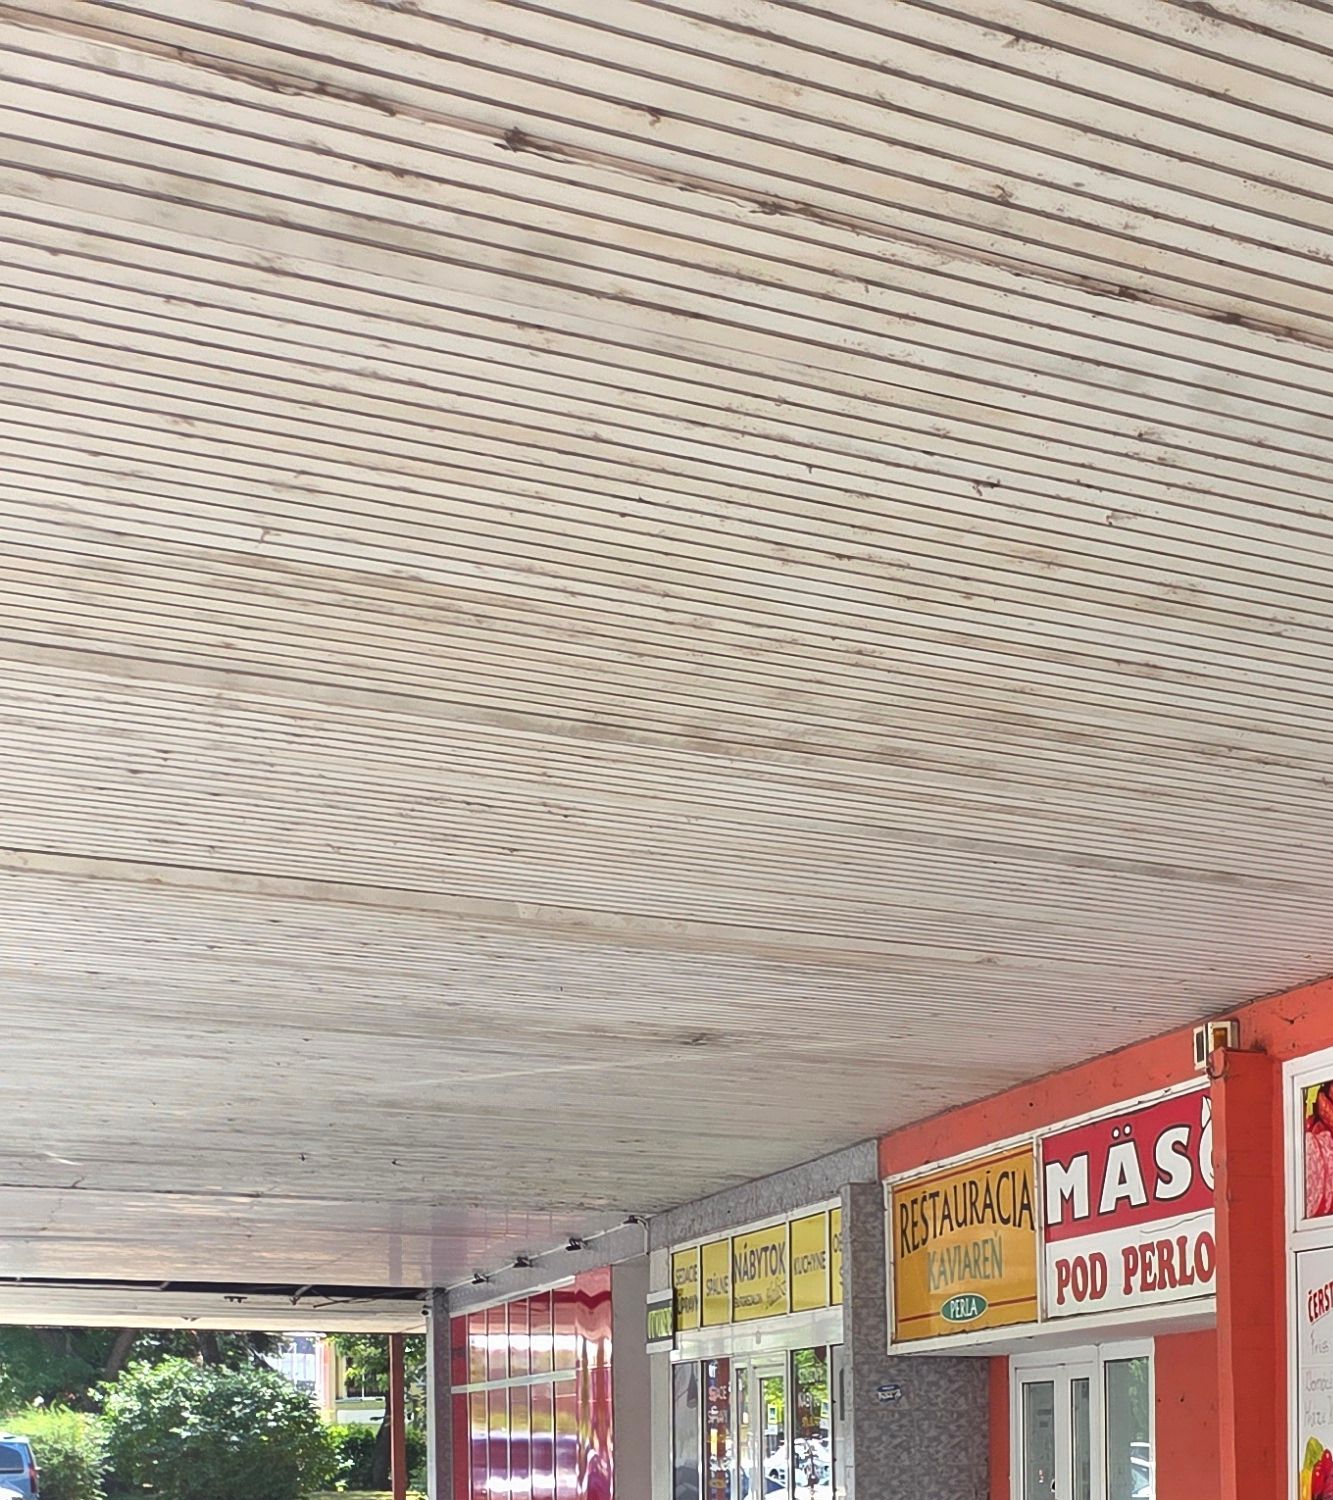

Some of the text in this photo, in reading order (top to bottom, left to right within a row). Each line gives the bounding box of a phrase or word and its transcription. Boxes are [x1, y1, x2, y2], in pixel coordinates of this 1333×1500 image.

[734, 1241, 786, 1284] NÁBYTOK
[926, 1233, 1003, 1293] KAVIAREŇ
[1055, 1231, 1216, 1305] POD PERLO
[950, 1297, 978, 1319] PERLA
